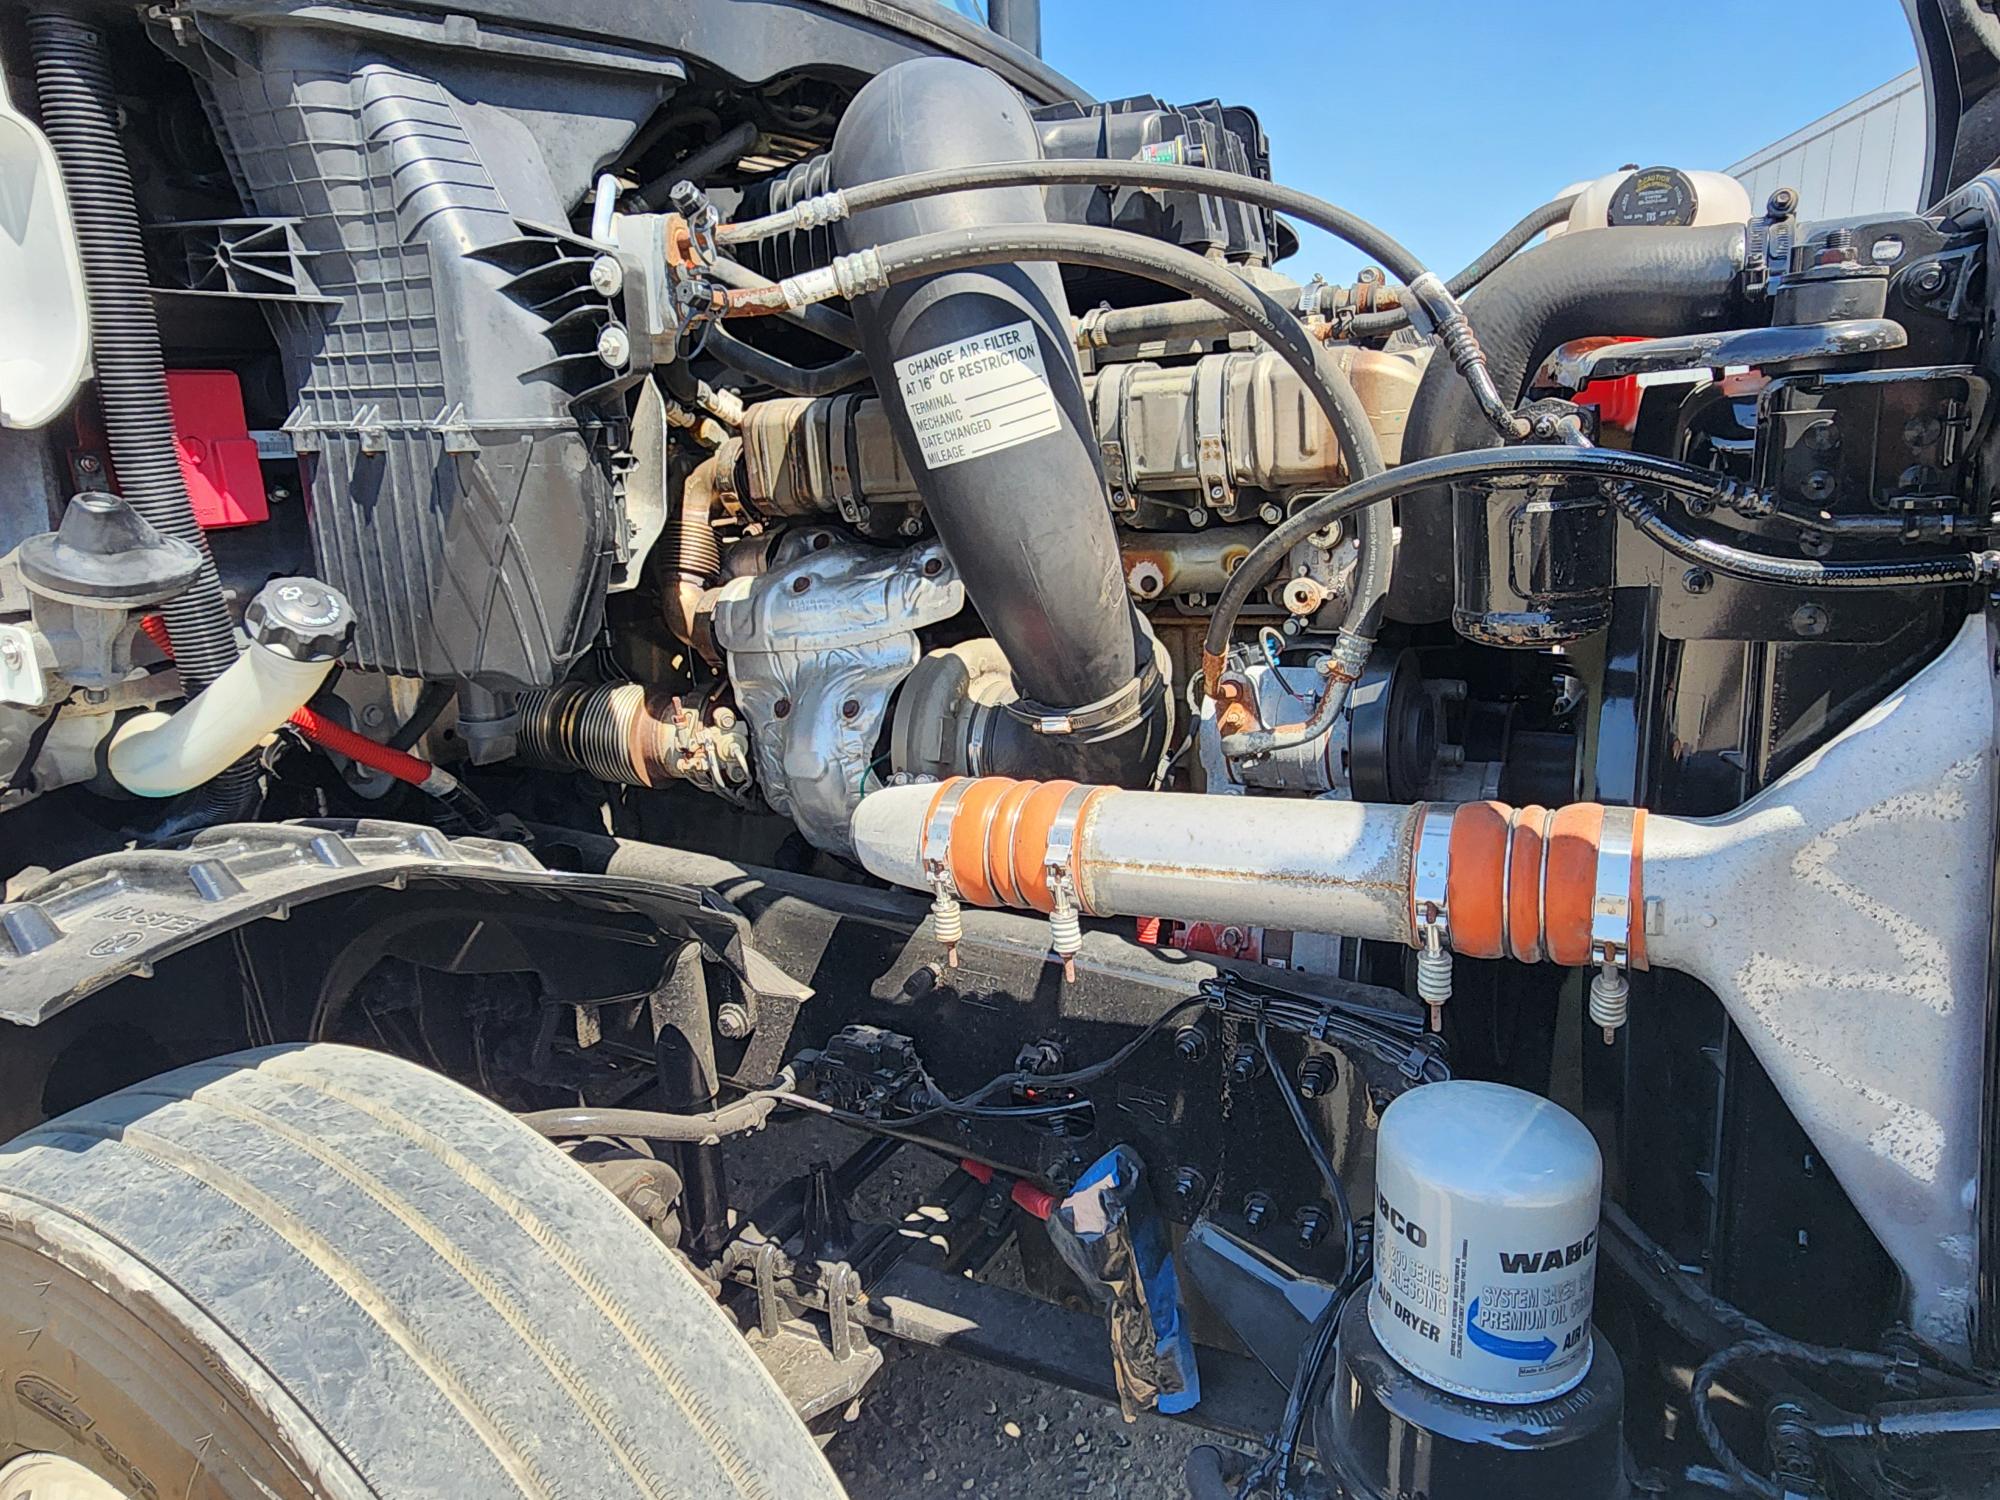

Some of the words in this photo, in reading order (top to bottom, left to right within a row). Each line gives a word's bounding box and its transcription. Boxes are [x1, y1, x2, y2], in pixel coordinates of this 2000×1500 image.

[908, 350, 956, 375] CHANGE
[959, 342, 980, 361] AIR
[984, 330, 1021, 350] FILTER
[906, 382, 918, 396] AT
[919, 374, 935, 392] 16"
[940, 369, 955, 385] OF
[958, 344, 1036, 380] RESTRICTION
[911, 393, 957, 417] TERMINAL
[916, 409, 963, 433] MECHANIC
[922, 433, 944, 449] DATE
[944, 418, 992, 442] CHANGED
[927, 445, 966, 465] MILEAGE
[1376, 1183, 1427, 1248] BCO
[1499, 1227, 1597, 1274] WABC
[1410, 1259, 1449, 1295] SERIES
[1378, 1280, 1392, 1310] AIR
[1394, 1300, 1442, 1343] DRYER
[1483, 1287, 1539, 1309] SYSTEM
[1480, 1307, 1547, 1331] PREMIUM
[1551, 1304, 1568, 1327] OIL
[1562, 1325, 1582, 1352] AIR
